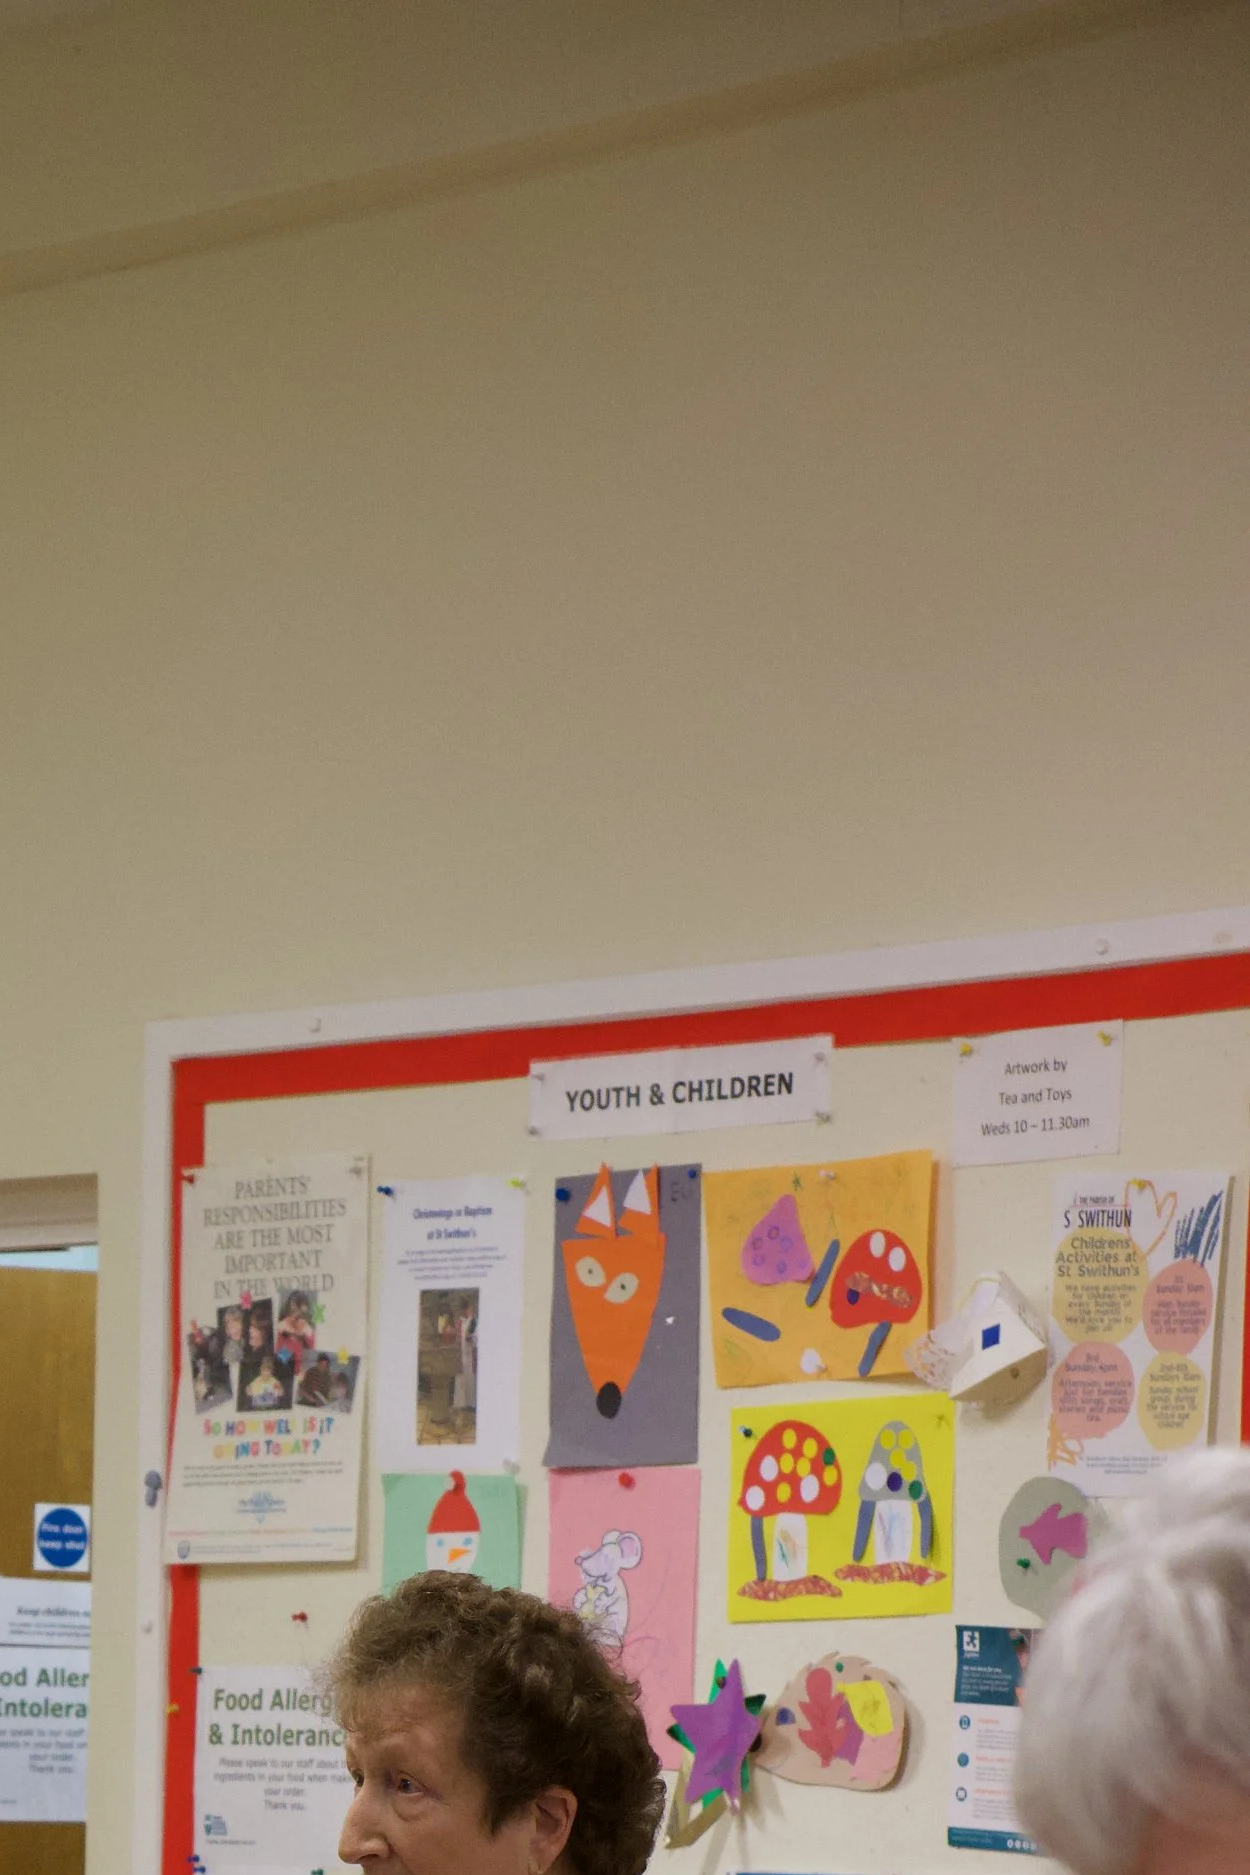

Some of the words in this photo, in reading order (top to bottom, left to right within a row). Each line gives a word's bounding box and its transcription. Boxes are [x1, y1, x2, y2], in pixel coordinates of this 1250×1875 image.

[1004, 1058, 1050, 1075] Artwork
[1053, 1057, 1068, 1072] by
[566, 1086, 640, 1112] YOUTH
[650, 1083, 665, 1106] &
[672, 1072, 793, 1104] CHILDREN
[999, 1092, 1017, 1105] Tea
[1021, 1088, 1042, 1104] and
[1046, 1088, 1072, 1103] Toys
[981, 1121, 1010, 1136] Weds
[1015, 1120, 1028, 1133] 10
[1041, 1116, 1090, 1132] 11.30am
[204, 1198, 346, 1226] RESPONSIBILITIES
[1078, 1208, 1132, 1229] SWITHUN
[214, 1231, 245, 1249] ARE
[252, 1227, 282, 1247] THE
[287, 1224, 334, 1245] MOST
[1071, 1237, 1130, 1250] Childrens
[225, 1250, 323, 1274] IMPORTANT
[1056, 1252, 1119, 1264] Activities
[1125, 1252, 1137, 1264] at
[1058, 1265, 1071, 1277] St
[1078, 1264, 1140, 1277] Swithun's
[214, 1280, 230, 1299] IN
[237, 1278, 267, 1296] THE
[203, 1418, 221, 1436] SO
[41, 1522, 60, 1532] Fire
[62, 1523, 83, 1534] door
[39, 1540, 62, 1550] keep
[65, 1540, 85, 1550] shut
[43, 1606, 80, 1617] children
[36, 1667, 90, 1688] Aller
[214, 1688, 263, 1711] Food
[270, 1688, 332, 1717] Allerg
[209, 1723, 223, 1746] &
[231, 1723, 347, 1746] Intoleranc
[219, 1757, 243, 1768] Please
[246, 1757, 268, 1769] speak
[270, 1759, 278, 1768] to
[280, 1760, 293, 1768] our
[296, 1757, 314, 1769] staff
[316, 1757, 338, 1769] about
[214, 1772, 256, 1783] ingredients
[258, 1772, 266, 1783] in
[268, 1772, 285, 1783] your
[287, 1772, 304, 1783] food
[307, 1772, 328, 1783] when
[264, 1788, 281, 1798] your
[264, 1800, 287, 1810] Thank
